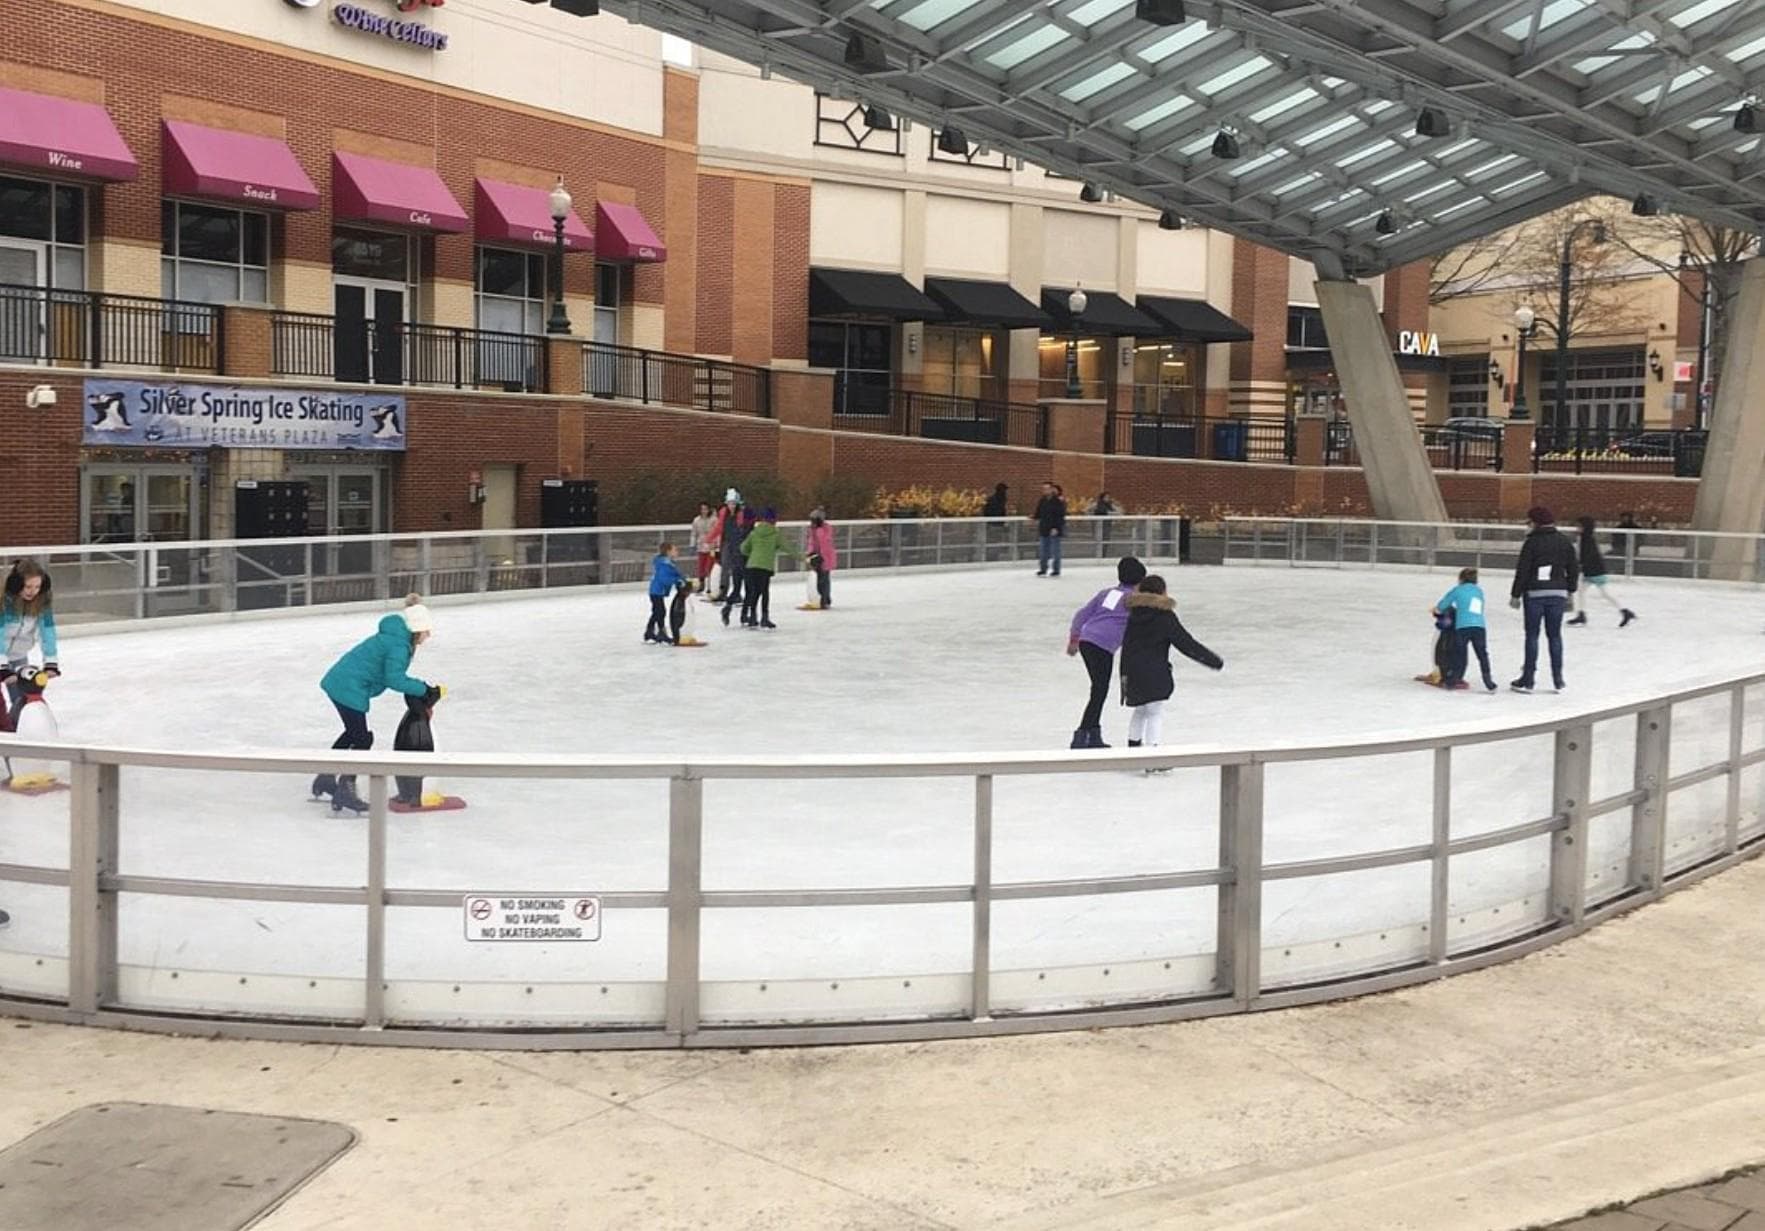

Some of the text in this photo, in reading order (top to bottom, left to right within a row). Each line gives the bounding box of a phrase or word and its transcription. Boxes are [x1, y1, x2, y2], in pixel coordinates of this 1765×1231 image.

[335, 4, 389, 34] Wine
[388, 20, 448, 49] Cellars
[48, 152, 82, 169] Wine
[243, 184, 278, 201] Snack
[1400, 330, 1440, 357] CAVA
[139, 388, 363, 428] Silver Spring Ice Skating
[175, 426, 329, 445] AT VETERANS PLAZA
[500, 899, 566, 911] NO SMOKING
[505, 914, 560, 924] NO VAPING
[481, 927, 582, 938] NO SKATEBOARDING
